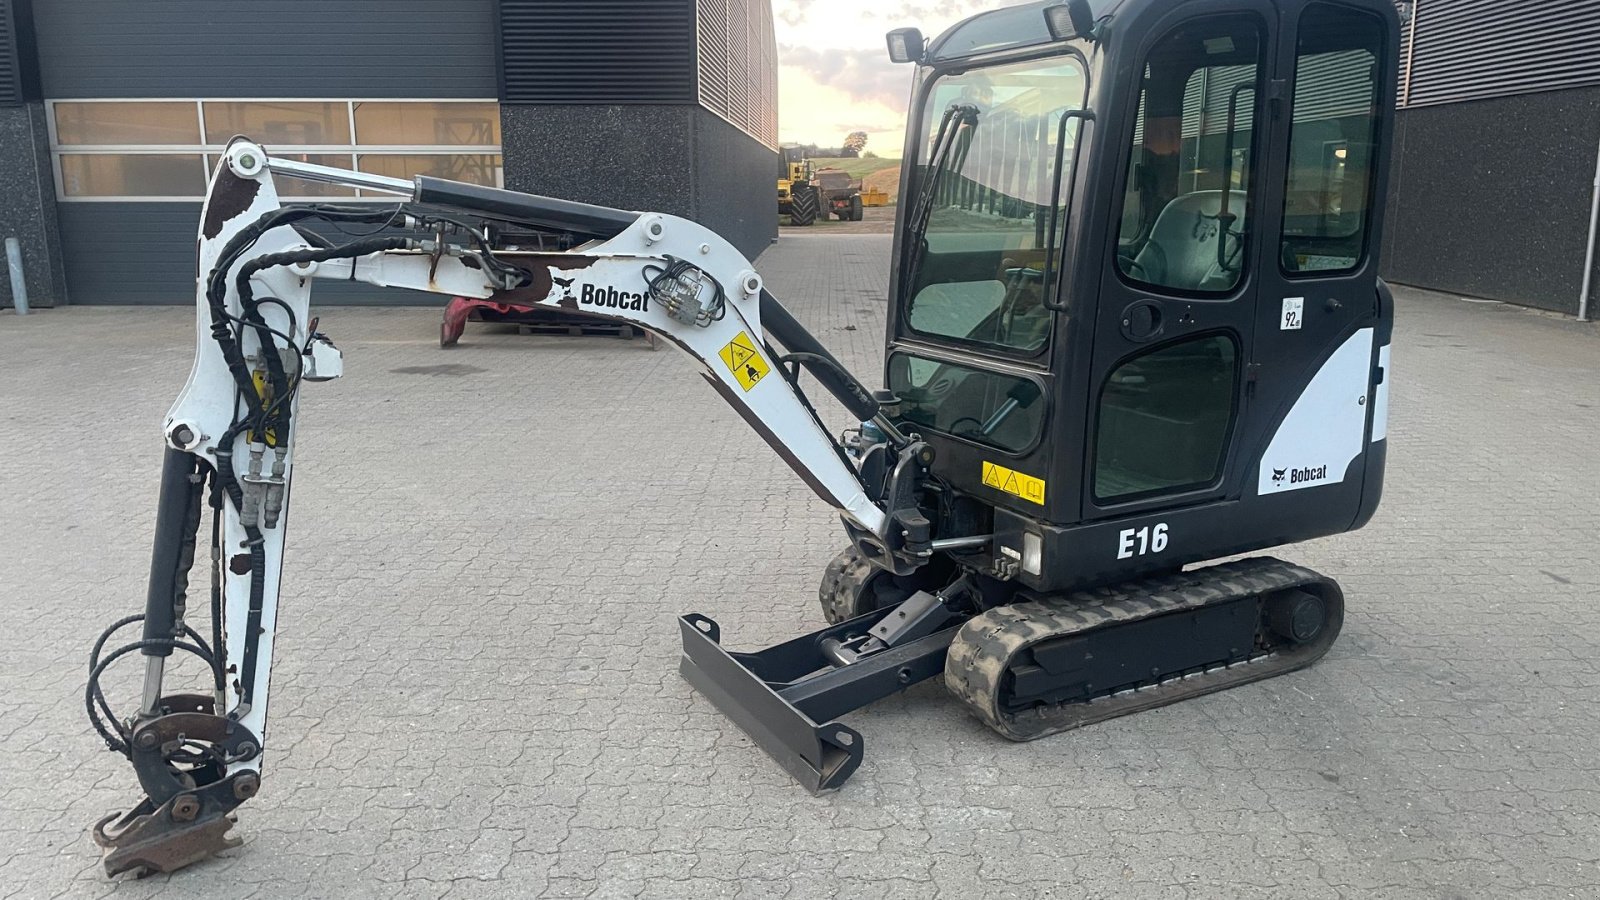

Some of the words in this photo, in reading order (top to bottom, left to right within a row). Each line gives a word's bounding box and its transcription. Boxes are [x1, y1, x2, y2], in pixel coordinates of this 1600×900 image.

[581, 283, 649, 312] Bobcat
[1285, 311, 1296, 327] 92
[1291, 465, 1327, 483] Bobcat
[1116, 522, 1169, 560] E16
